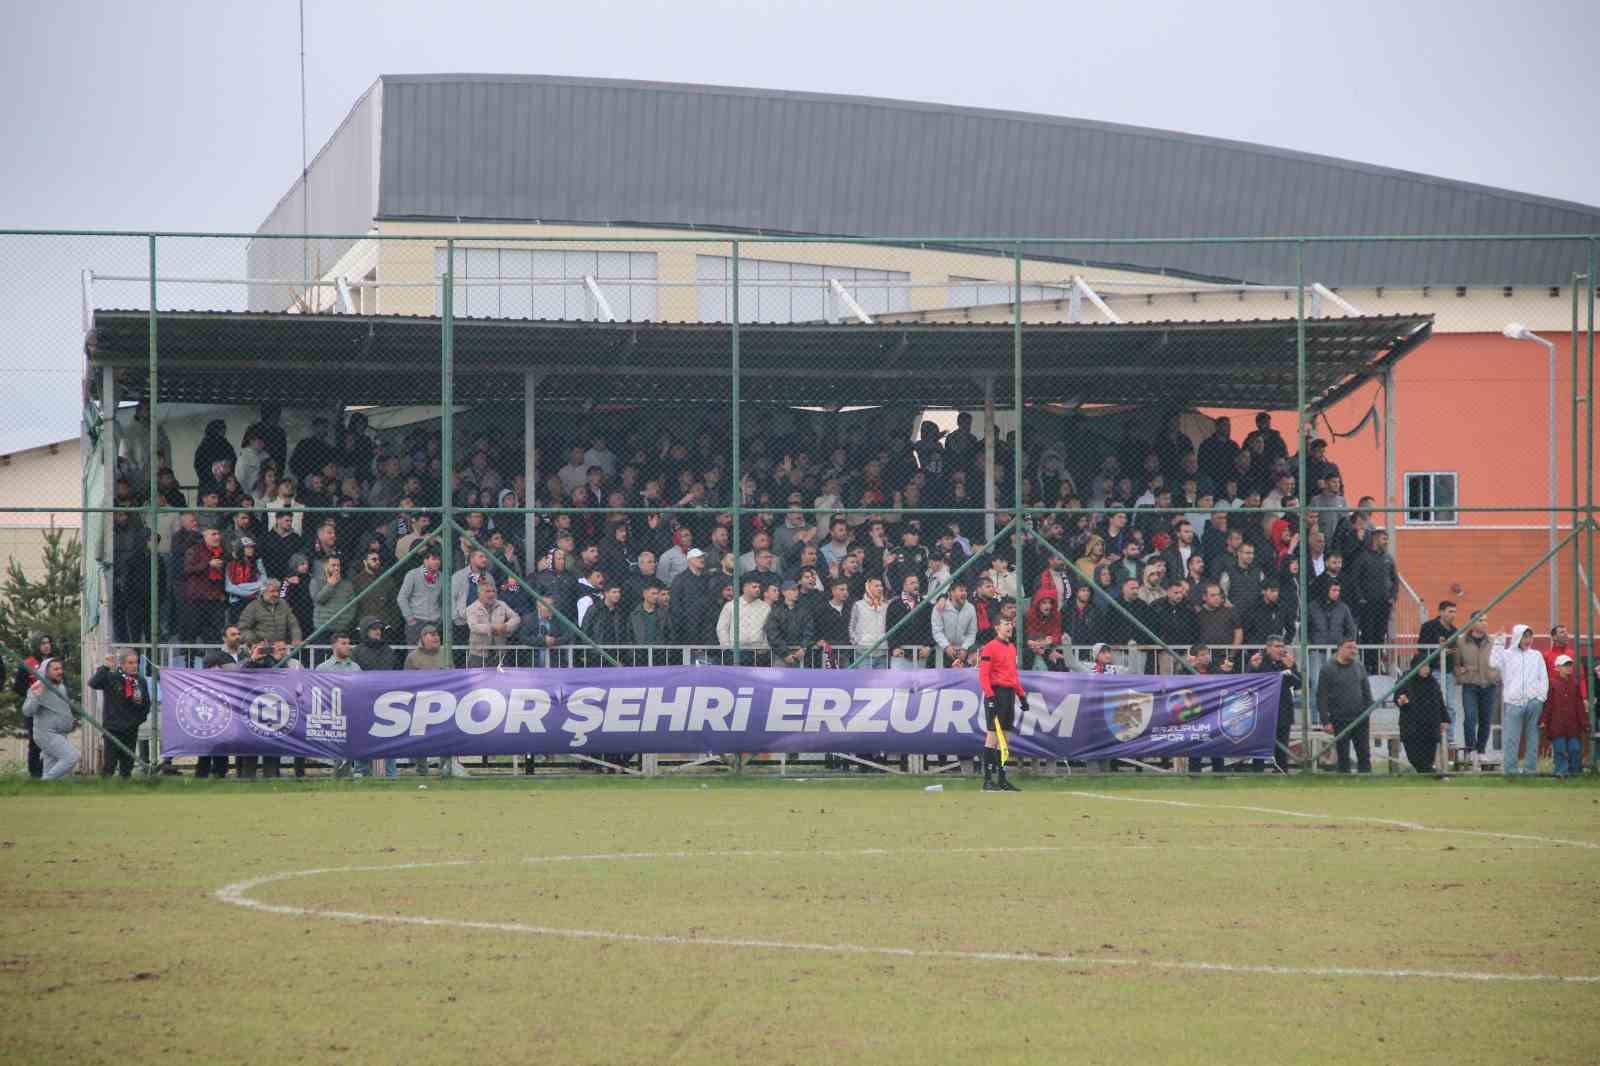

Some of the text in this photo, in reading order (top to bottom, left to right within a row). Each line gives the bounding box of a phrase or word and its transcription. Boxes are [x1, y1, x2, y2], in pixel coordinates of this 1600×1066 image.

[368, 687, 551, 737] SPOR
[764, 687, 1081, 738] ERZURM
[1151, 733, 1185, 742] SPOR
